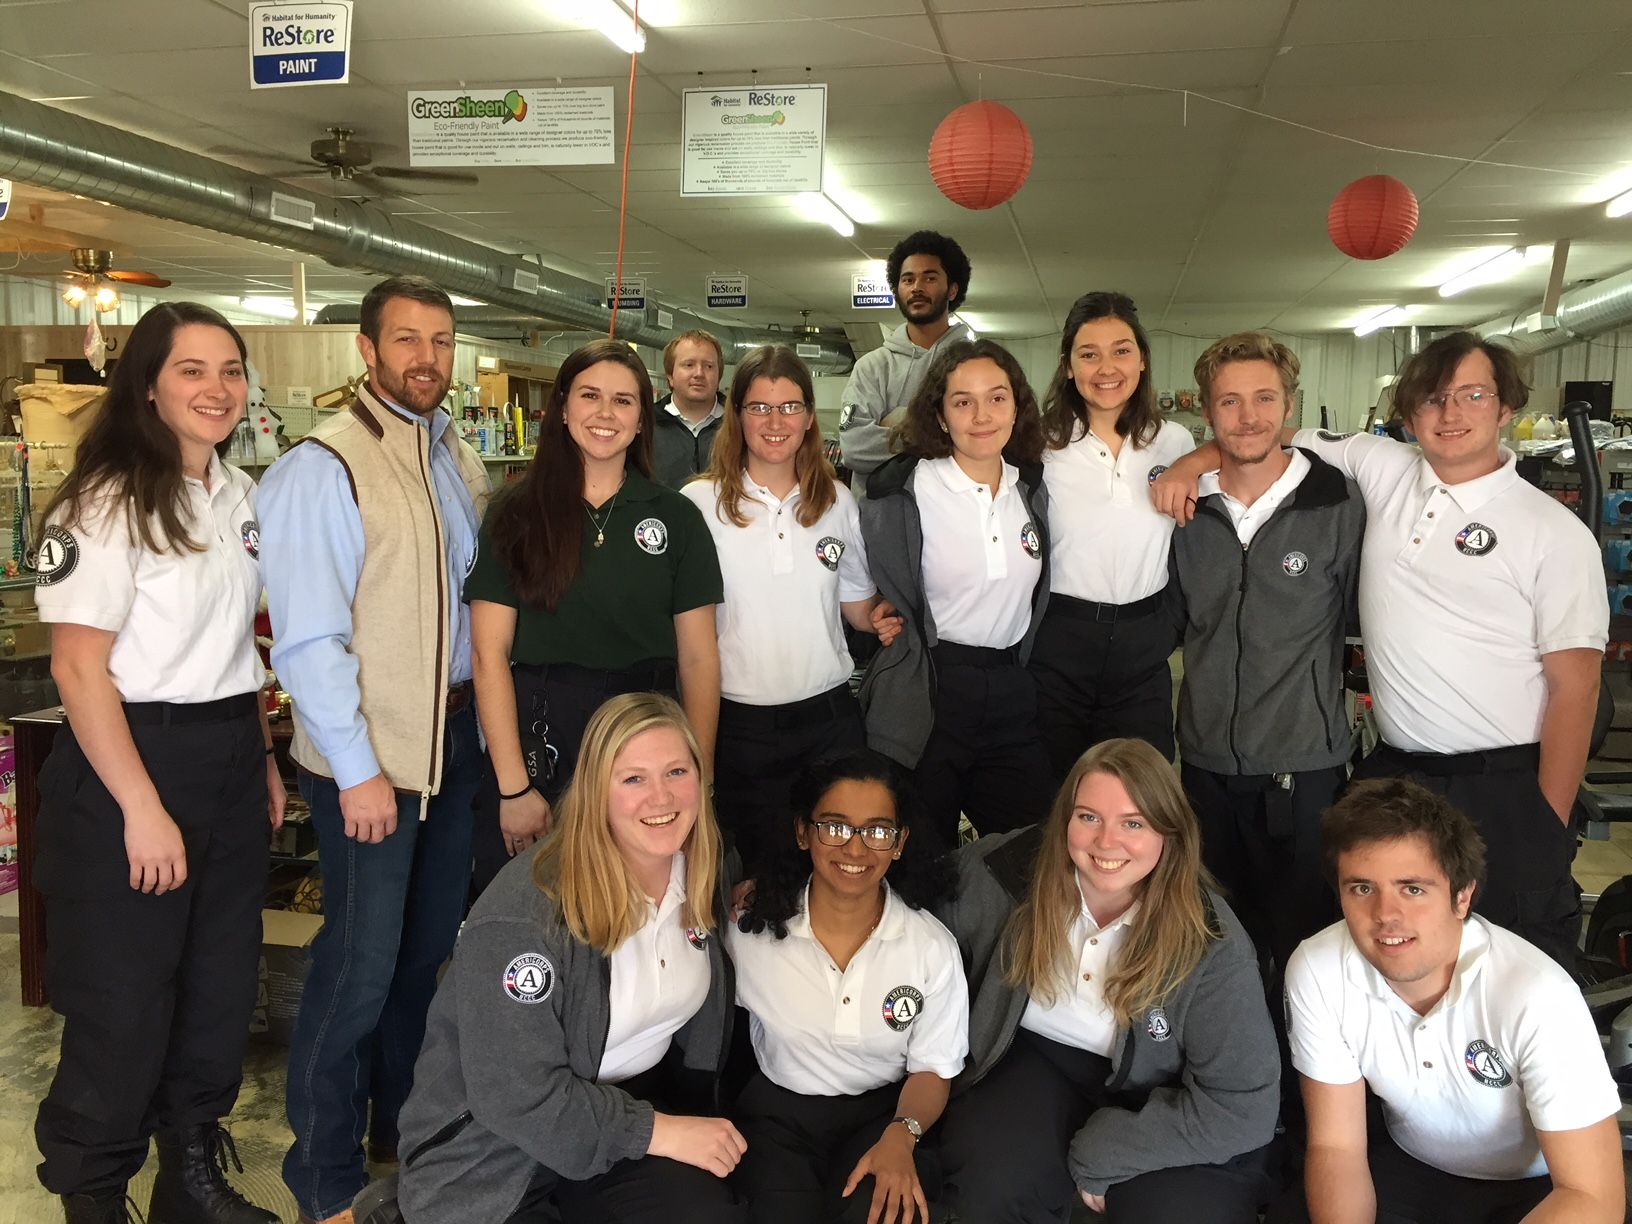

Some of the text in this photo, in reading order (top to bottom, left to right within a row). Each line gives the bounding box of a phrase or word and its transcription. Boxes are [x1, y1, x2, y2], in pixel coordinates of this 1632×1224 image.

[272, 14, 294, 22] Habitat
[305, 13, 336, 21] Humanity
[262, 24, 335, 47] ReStore
[279, 58, 318, 75] PAINT
[748, 92, 796, 106] ReStore
[412, 96, 506, 119] GreenSheen
[433, 121, 500, 131] Eco-Friendly Paint
[610, 286, 641, 296] RStore
[711, 284, 742, 294] ReStore
[711, 297, 743, 305] HARDWARE
[856, 296, 891, 304] ELECTRICAL
[646, 528, 659, 543] A
[1467, 530, 1484, 548] A
[39, 540, 56, 567] A
[828, 544, 838, 559] A
[1290, 558, 1301, 569] A
[36, 575, 51, 584] CCC
[528, 750, 538, 777] GSA
[512, 957, 550, 974] AMERICORPS
[519, 968, 538, 988] A
[896, 998, 913, 1018] A
[1155, 1018, 1166, 1031] A
[1481, 1054, 1501, 1076] A
